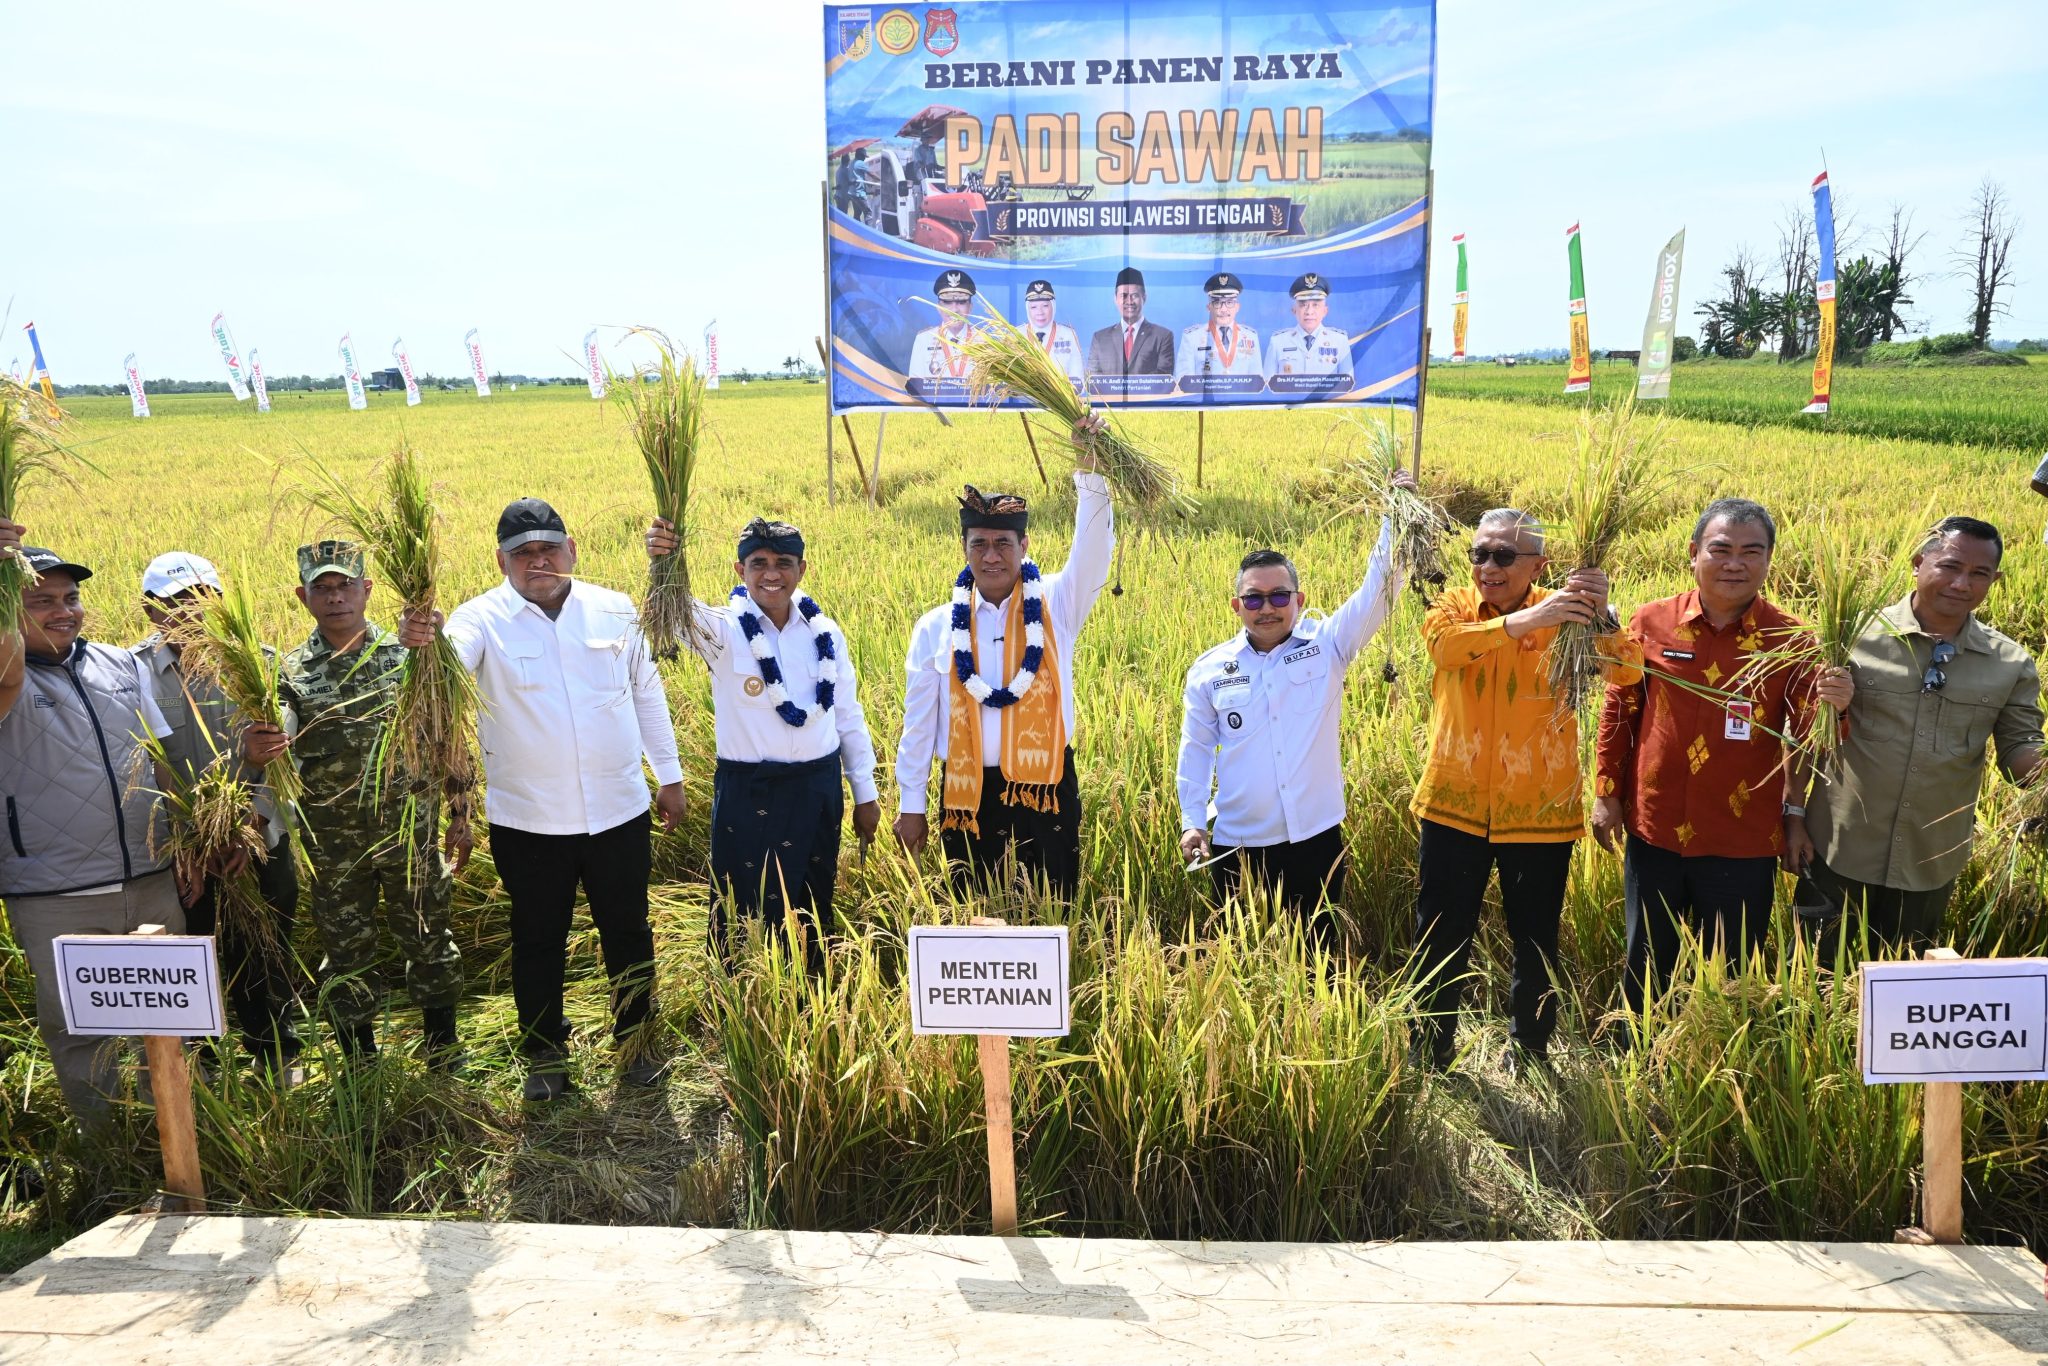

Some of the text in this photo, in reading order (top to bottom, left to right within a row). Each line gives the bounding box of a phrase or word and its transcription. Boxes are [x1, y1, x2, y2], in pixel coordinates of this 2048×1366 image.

[924, 53, 1343, 89] BERANI PANEN RAYA
[944, 106, 1324, 187] PADI SAWAH
[1016, 203, 1266, 229] PROVINSI SULAWESI TENGAH
[1286, 646, 1320, 663] BUPATI
[1215, 676, 1248, 688] AMIRUDIN
[75, 966, 198, 985] GUBERNUR
[940, 961, 1038, 980] MENTERI
[90, 990, 190, 1009] SULTENG
[928, 987, 1052, 1006] PERTANIAN
[1907, 1003, 2010, 1024] BUPATI
[1890, 1029, 2027, 1050] BANGGAI
